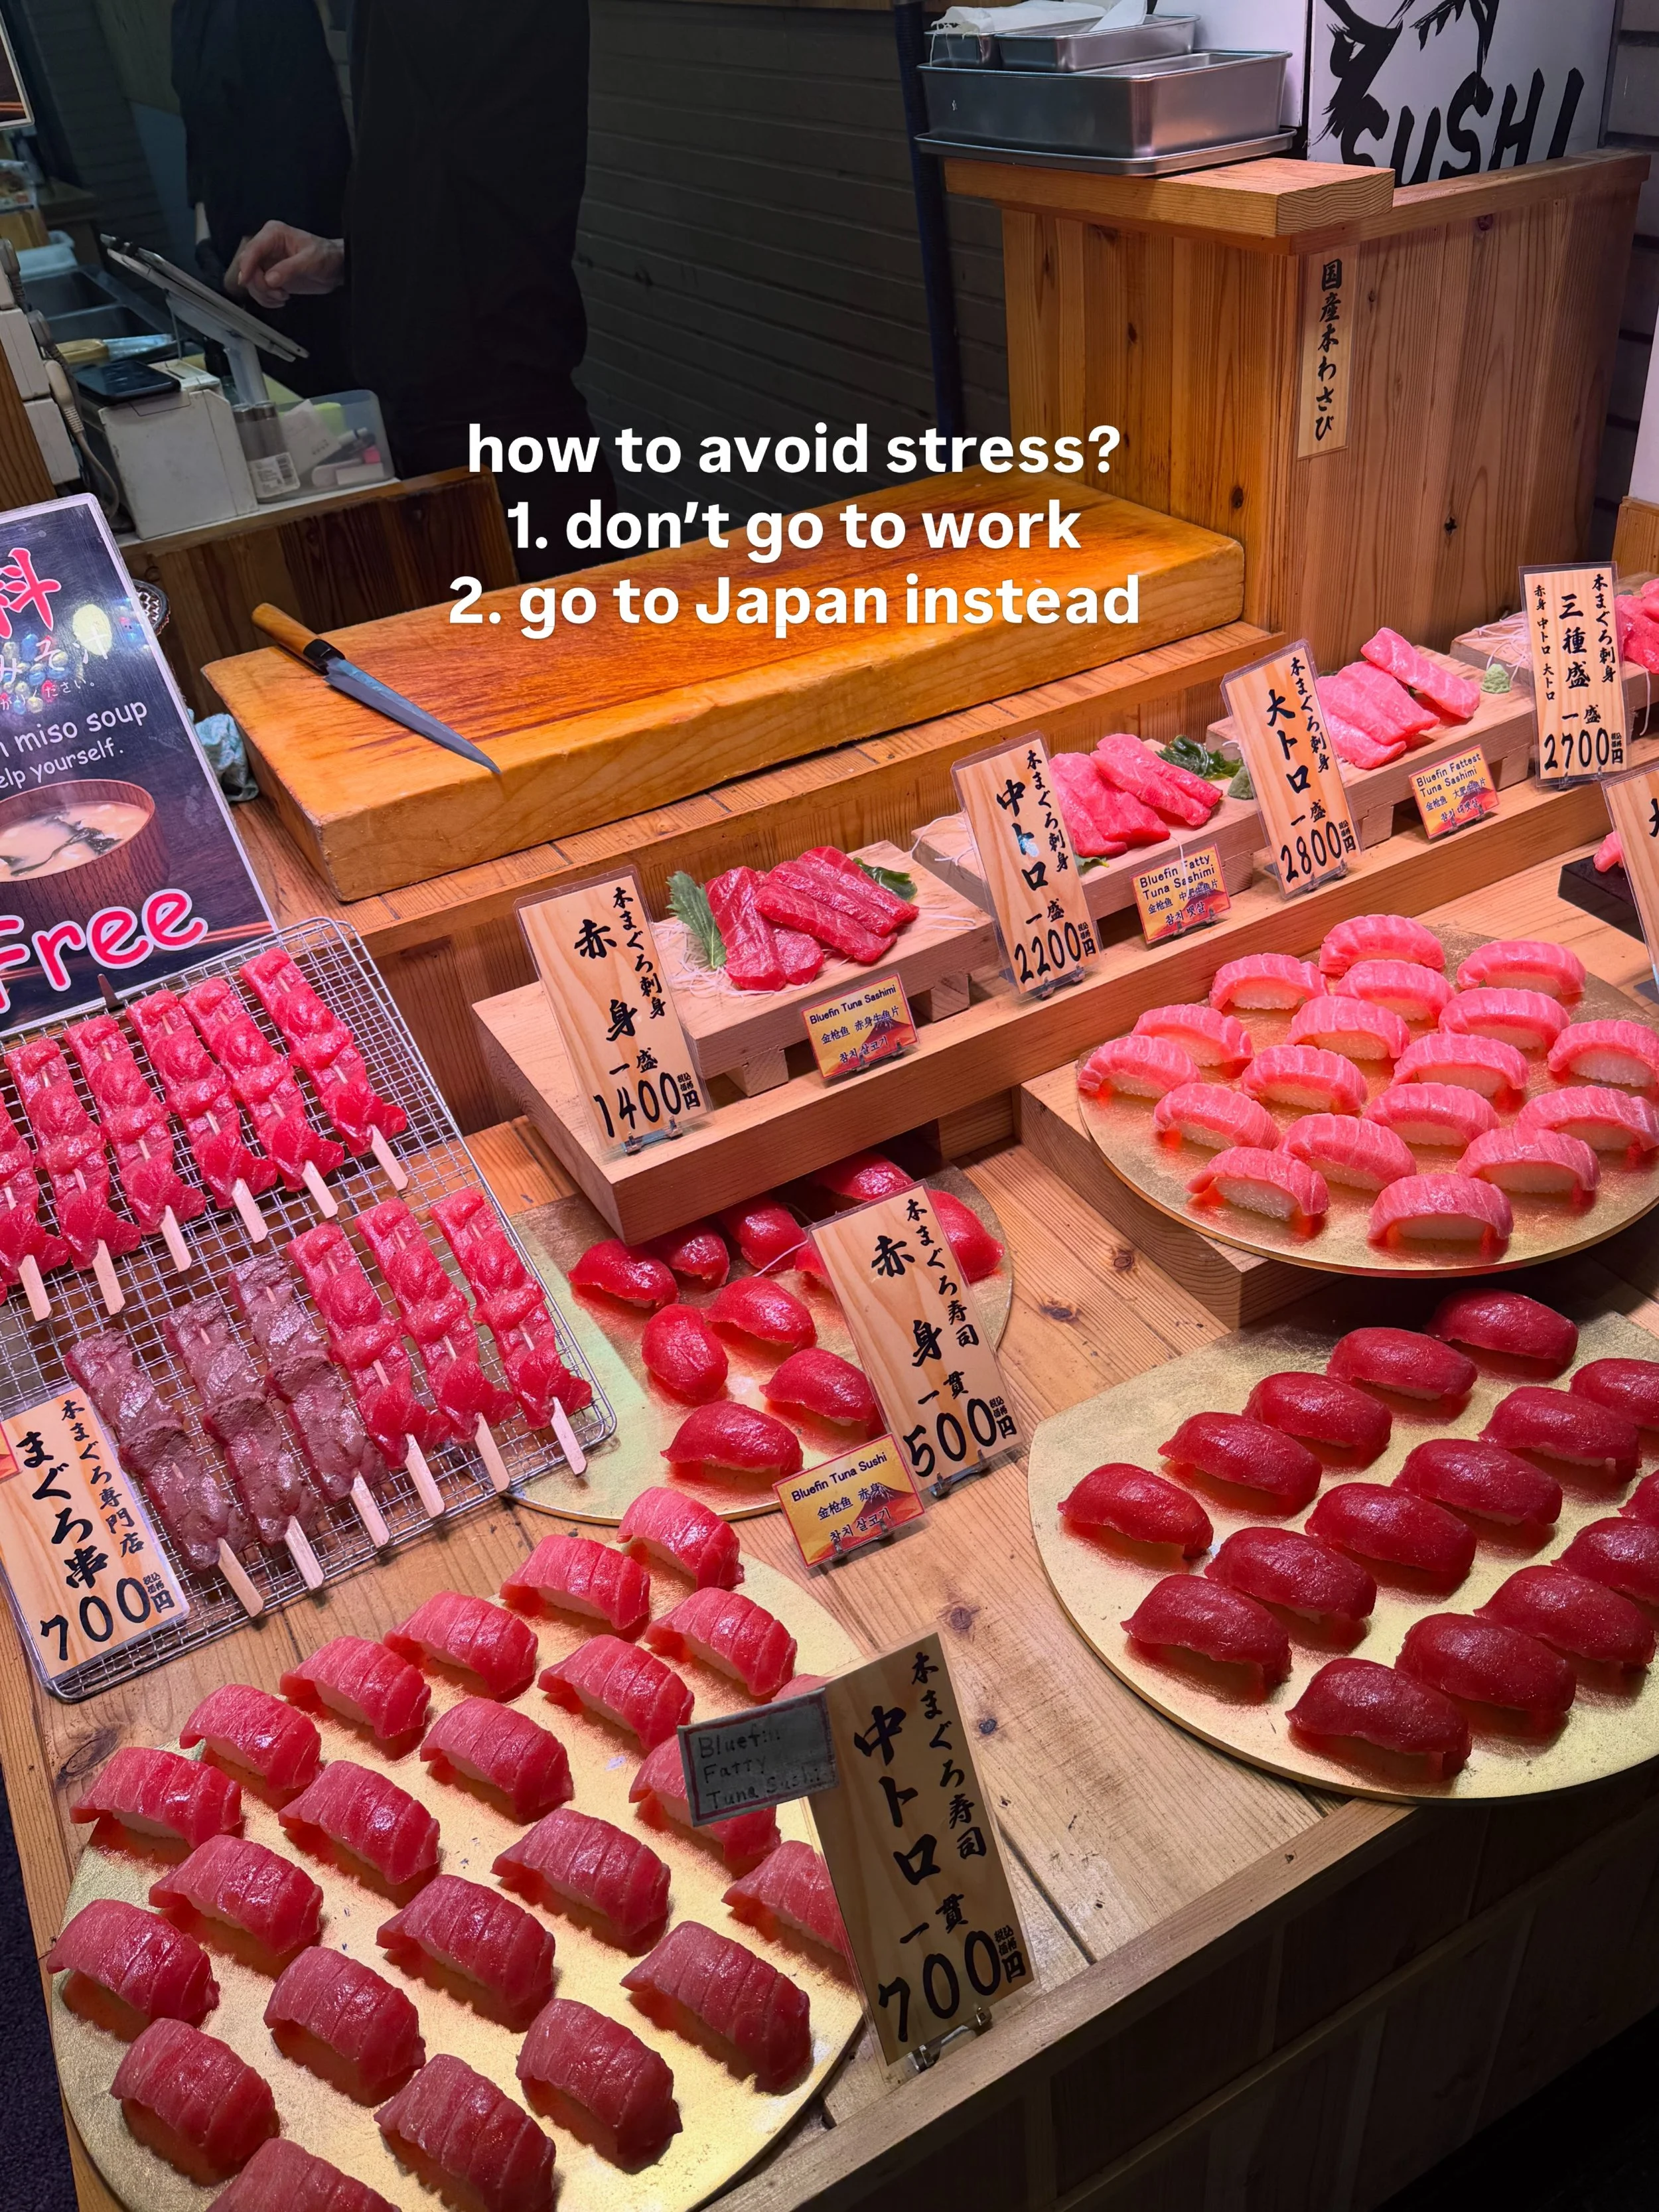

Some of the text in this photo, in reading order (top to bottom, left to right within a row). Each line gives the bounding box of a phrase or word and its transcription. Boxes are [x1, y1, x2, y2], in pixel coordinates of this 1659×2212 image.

[1340, 67, 1585, 188] SUSHI
[1315, 259, 1343, 442] 国産本わさび
[1559, 593, 1591, 689] 三種盛
[1592, 574, 1616, 684] 本まぐろ刺身
[14, 722, 78, 753] miso
[86, 701, 147, 732] soup
[29, 737, 124, 783] yourself.
[1267, 688, 1311, 794] 大トロ
[1291, 657, 1330, 773] 本まぐろ刺身
[1561, 704, 1601, 725] 一盛
[1027, 750, 1068, 872] 本まぐろ刺身
[1291, 799, 1326, 827] 一盛
[1416, 753, 1480, 787] Bluefin Fattest
[1420, 766, 1477, 797] Tuna Sashimi
[996, 779, 1048, 891] 中トロ
[1140, 867, 1178, 888] Bluefin
[1143, 864, 1215, 900] Tuna Sashimi
[613, 886, 666, 1019] 本まぐろ刺身
[1025, 898, 1064, 925] 一盛
[574, 919, 638, 1042] 赤身
[810, 984, 897, 1024] Bluefin Tuna Sashimi
[609, 1047, 658, 1075] 一盛
[871, 1235, 942, 1367] 赤身
[906, 1199, 979, 1348] 本まぐろ寿司
[918, 1371, 969, 1406] 一貫
[15, 1431, 109, 1589] まぐろ串
[61, 1399, 144, 1558] 本まぐろ専門店
[791, 1451, 887, 1503] Bluefin Tuna Sushi
[706, 1786, 759, 1809] Tuna
[853, 1705, 942, 1885] 中トロ
[911, 1651, 987, 1860] 本まぐろ寿司
[900, 1893, 969, 1945] 一貫
